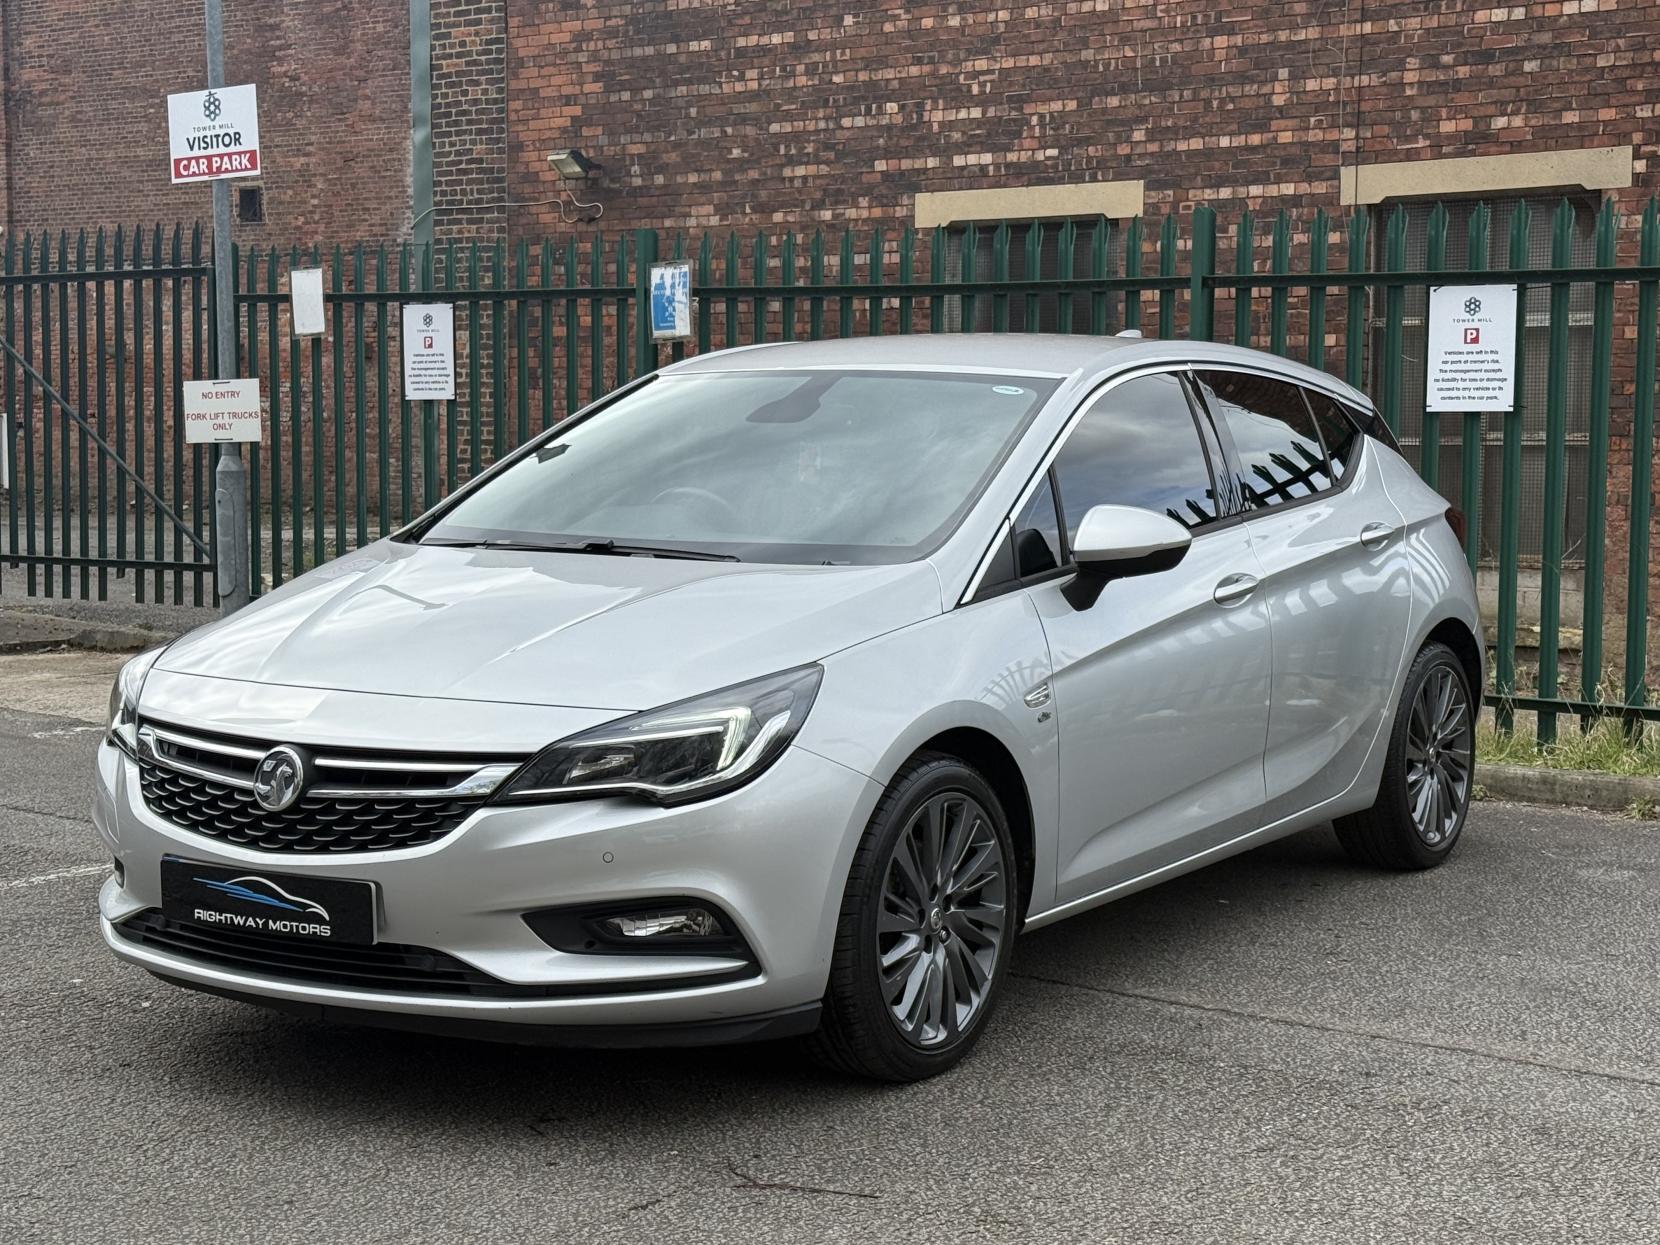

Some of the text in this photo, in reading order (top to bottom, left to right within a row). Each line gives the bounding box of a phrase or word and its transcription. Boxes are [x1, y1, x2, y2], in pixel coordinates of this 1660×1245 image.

[192, 122, 235, 133] TOWER MILL
[186, 131, 242, 151] VISITOR
[179, 153, 252, 176] CAR PARK
[1466, 329, 1477, 343] P
[425, 337, 432, 348] P
[201, 390, 241, 399] NO ENTRY
[186, 410, 260, 421] FORK LIFT TRUCKS
[212, 422, 234, 431] ONLY
[194, 908, 331, 937] RIGHTWAY MOTORS
